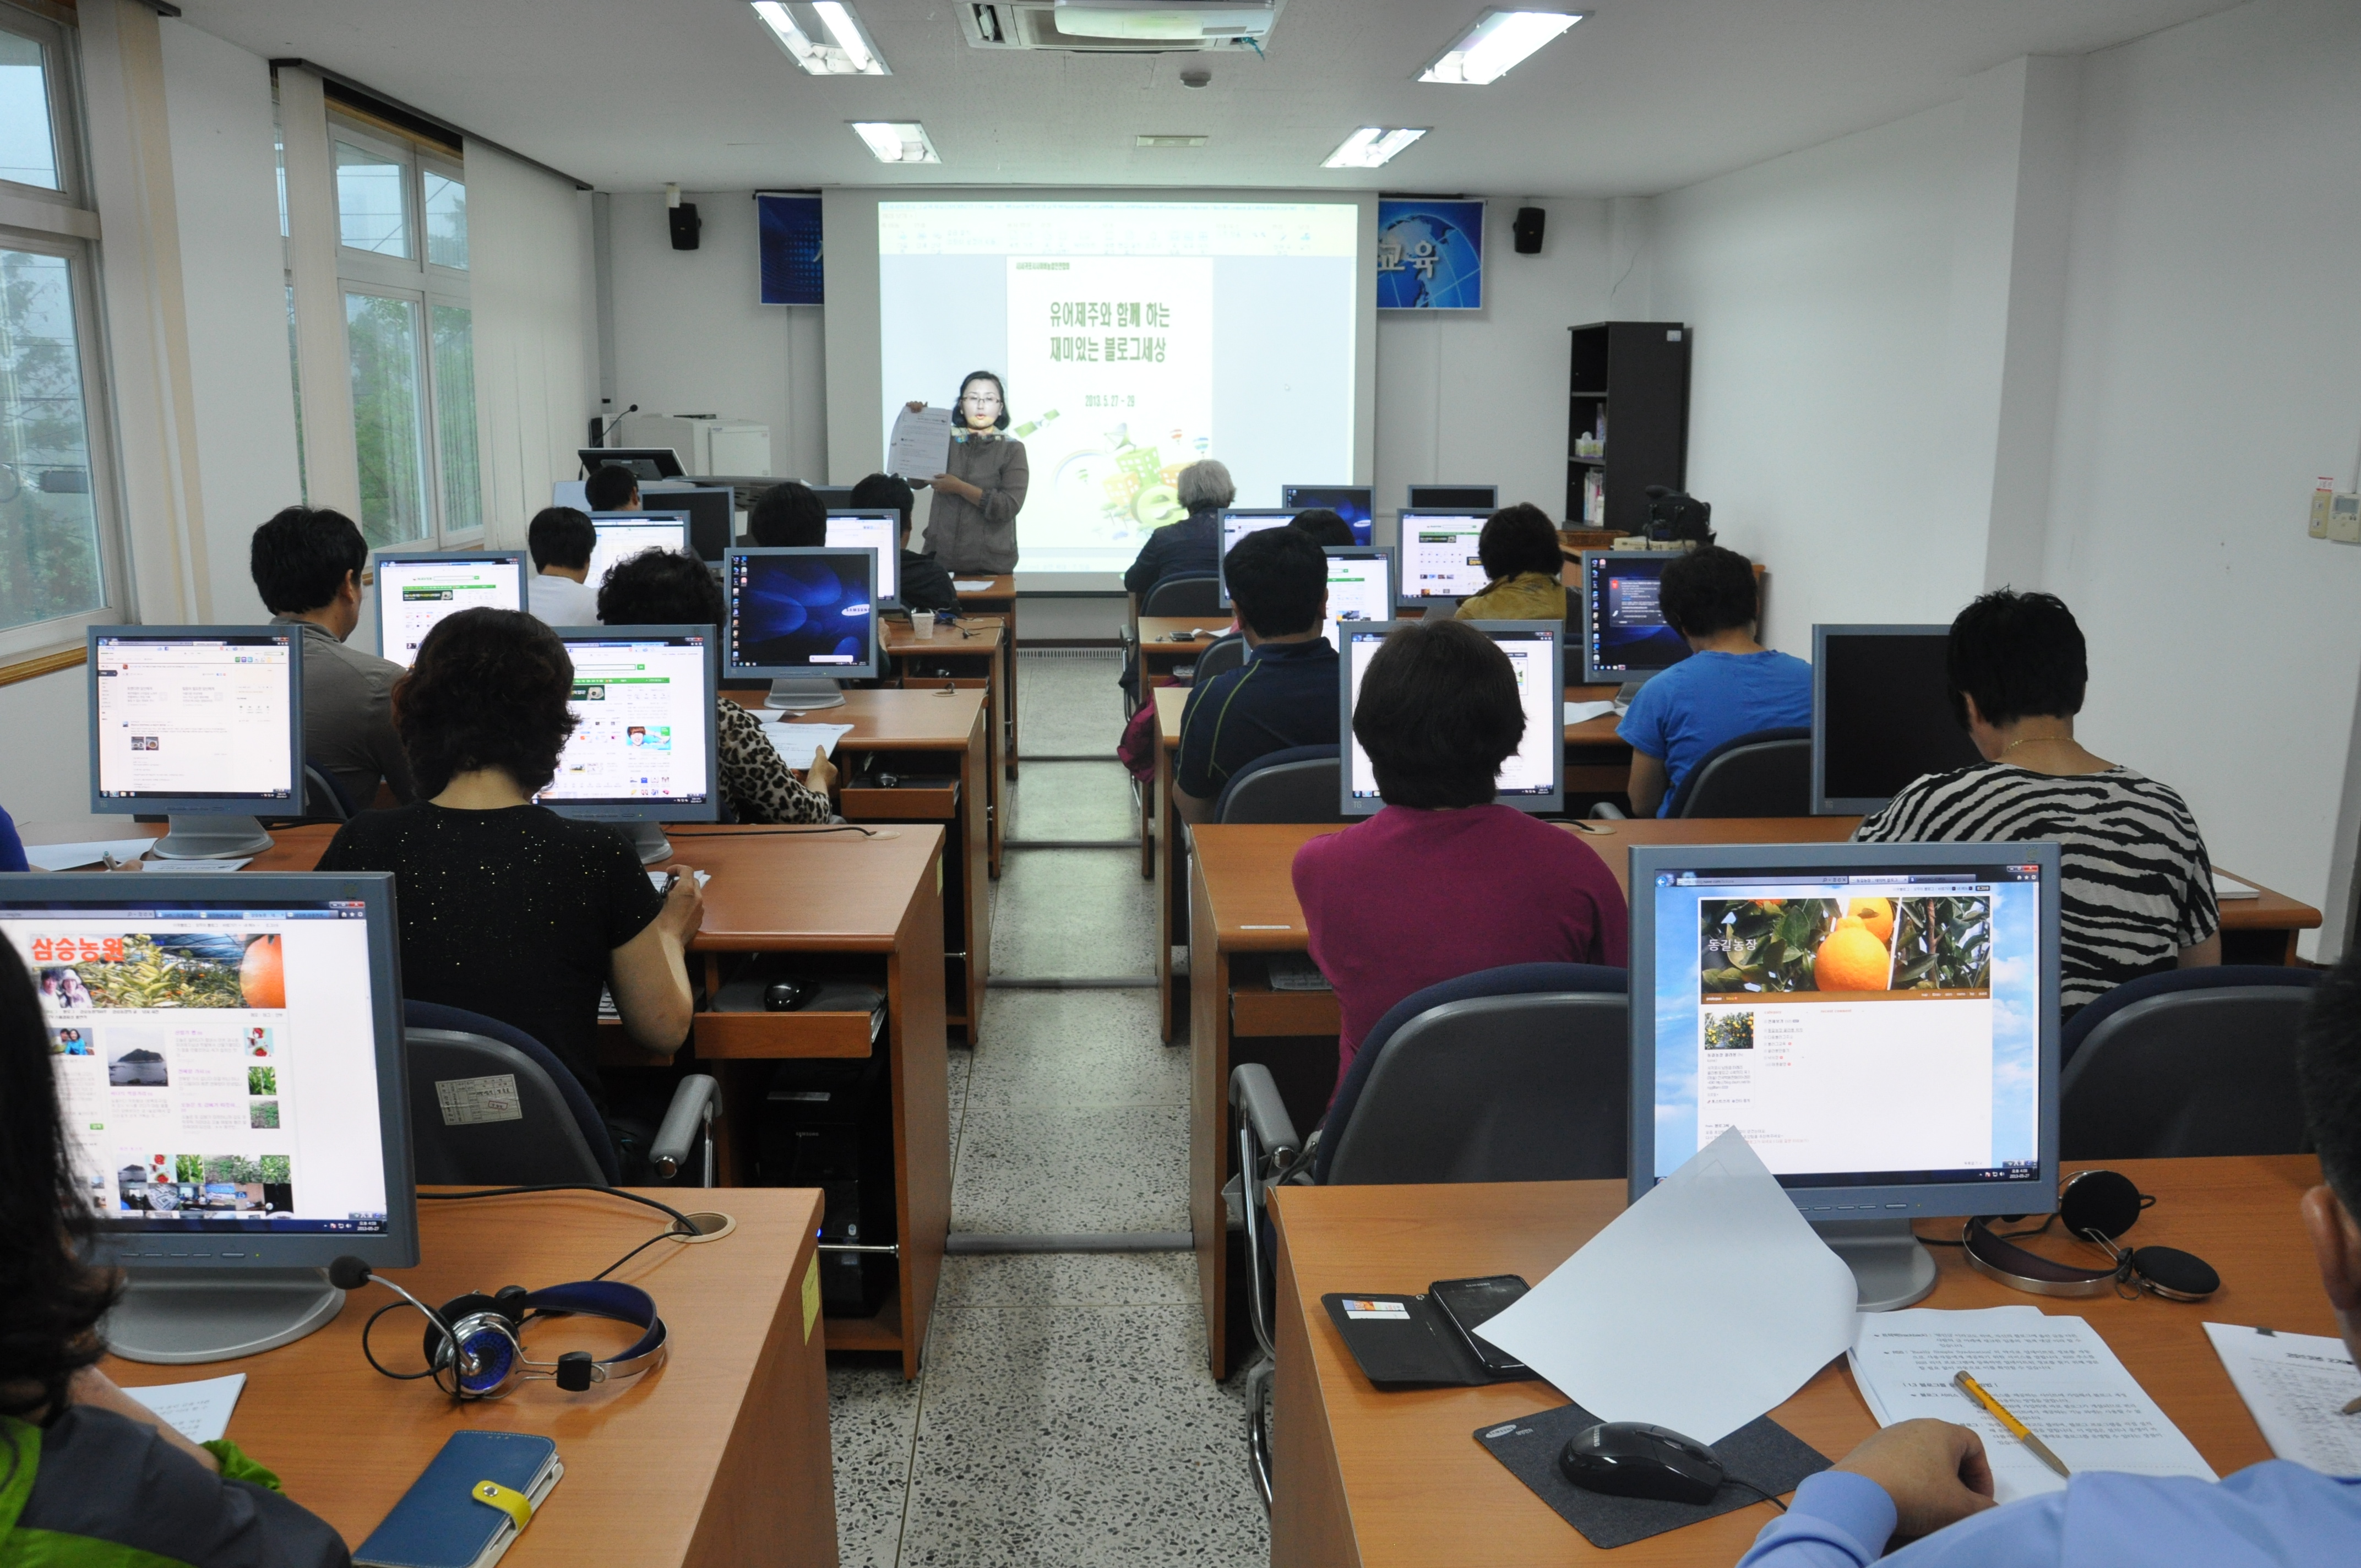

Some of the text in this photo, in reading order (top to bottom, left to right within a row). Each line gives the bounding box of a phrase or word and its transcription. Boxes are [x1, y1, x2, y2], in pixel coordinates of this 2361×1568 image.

[1050, 302, 1170, 328] 유어제주와 함께 하는
[1050, 336, 1166, 363] 재미있는 블로그세상
[1111, 395, 1118, 407] 27
[1127, 395, 1135, 407] 29
[32, 938, 124, 962] 삼승농원
[1708, 939, 1758, 951] 동길농장
